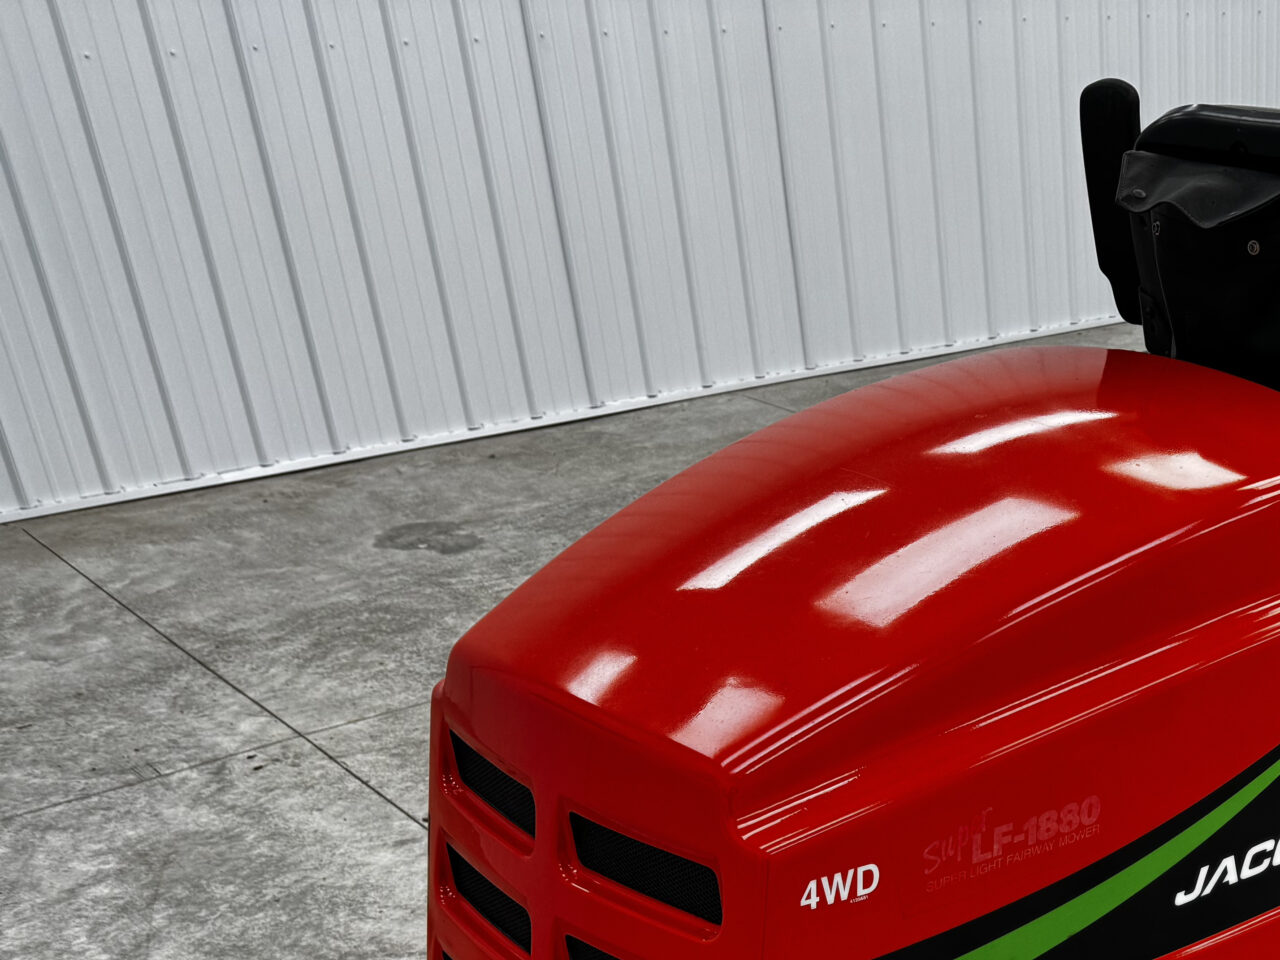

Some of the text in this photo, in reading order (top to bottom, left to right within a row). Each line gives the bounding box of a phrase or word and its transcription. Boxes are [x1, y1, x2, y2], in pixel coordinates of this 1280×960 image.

[970, 858, 1002, 878] LIGHT
[1006, 839, 1055, 865] FAIRWAY
[1059, 823, 1100, 847] MOWER
[972, 795, 1101, 864] LF-1880
[800, 863, 880, 910] 4WD
